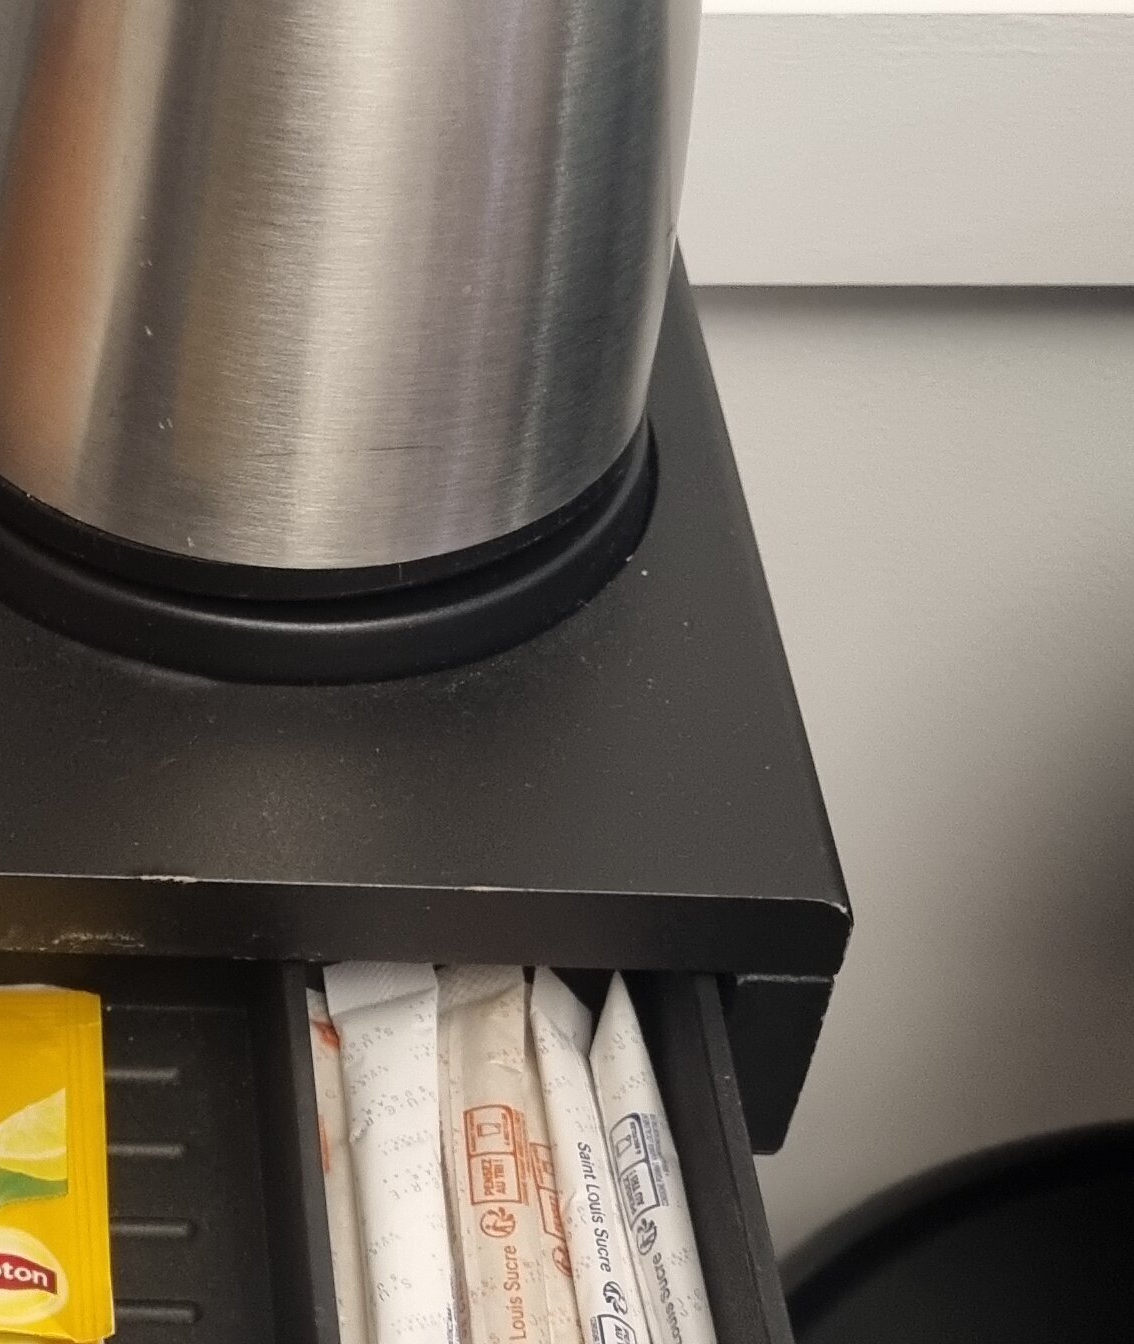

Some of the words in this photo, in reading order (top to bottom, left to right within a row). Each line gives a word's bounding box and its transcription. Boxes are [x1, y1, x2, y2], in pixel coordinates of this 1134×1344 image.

[482, 1158, 493, 1196] PENSEZ
[577, 1141, 596, 1182] Saint
[495, 1180, 506, 1195] AU
[586, 1182, 603, 1226] Louis
[634, 1191, 644, 1205] AU
[503, 1244, 520, 1292] Sucre
[593, 1227, 611, 1273] Sucre
[651, 1251, 671, 1304] Sucre
[507, 1295, 526, 1343] Louis
